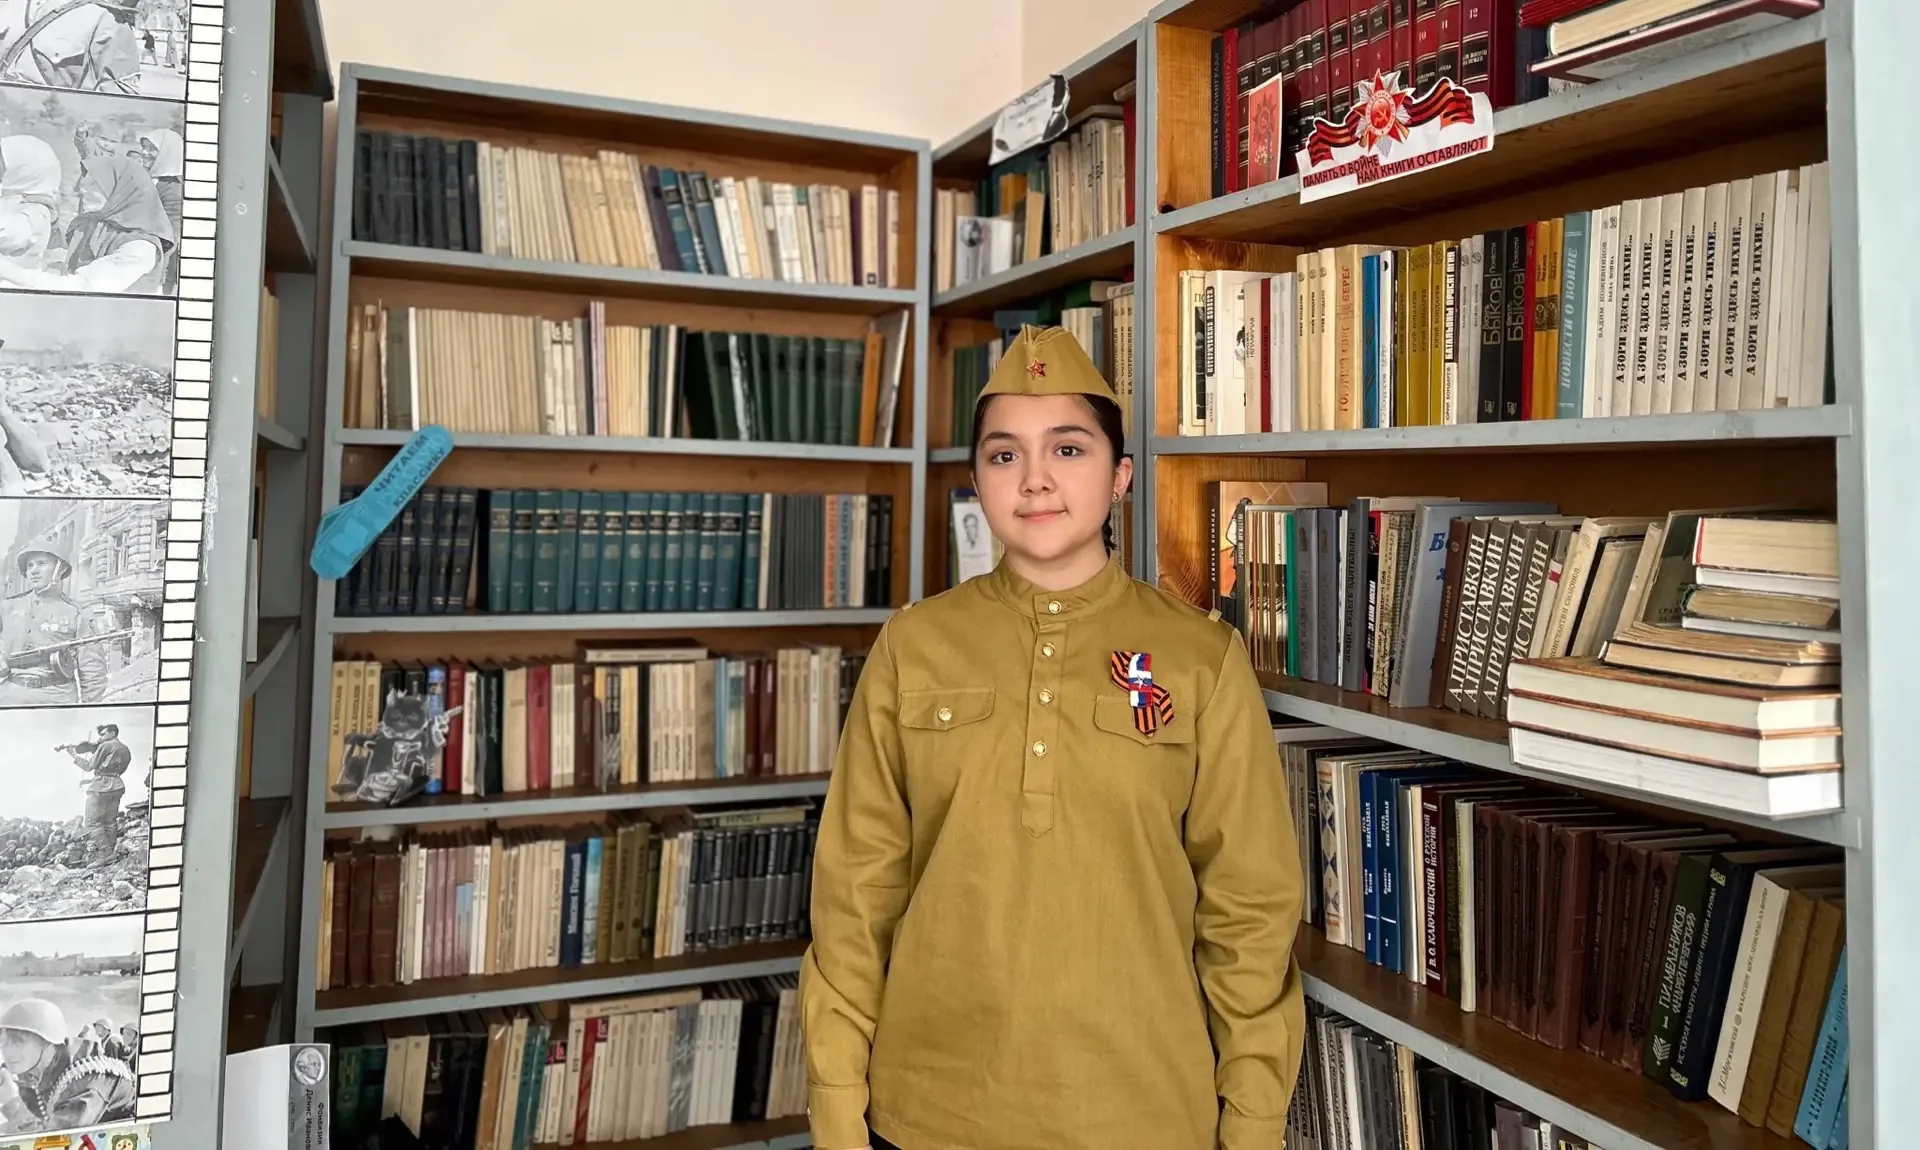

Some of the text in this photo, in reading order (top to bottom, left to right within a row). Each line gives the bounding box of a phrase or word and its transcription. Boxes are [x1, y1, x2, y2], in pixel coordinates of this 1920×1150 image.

[1469, 8, 1478, 18] 12
[1419, 30, 1427, 41] 10
[1335, 68, 1340, 77] 6
[1303, 155, 1379, 186] ПАМЯТЬ О ВОЙНЕ
[1357, 138, 1486, 184] НАМ КНИГИ ОСТАВЛЯЮТ
[1342, 266, 1350, 301] БЕРЕГ
[1599, 242, 1607, 302] КОЖЕВНИКОВ
[1445, 251, 1455, 359] БАТАЛЬОНЫ ПРОСЯТ ОГНЯ
[1561, 247, 1578, 389] ПОВЕСТИ О ВОЙНЕ
[1619, 292, 1630, 333] ЗДЕСЬ
[1639, 292, 1651, 333] ЗДЕСЬ
[1659, 290, 1671, 332] ЗДЕСЬ
[1681, 286, 1692, 329] ЗДЕСЬ
[1702, 284, 1714, 328] ЗДЕСЬ
[1728, 280, 1740, 325] ЗДЕСЬ
[1749, 277, 1762, 322] ЗДЕСЬ
[1616, 337, 1628, 372] ЗОРИ
[1637, 337, 1648, 372] ЗОРИ
[1658, 336, 1668, 371] ЗОРИ
[1678, 333, 1690, 368] ЗОРИ
[1700, 331, 1712, 367] ЗОРИ
[1725, 328, 1737, 364] ЗОРИ
[1746, 327, 1758, 363] ЗОРИ
[1615, 374, 1625, 384] А
[1637, 374, 1646, 384] А
[1656, 373, 1666, 384] А
[1678, 371, 1688, 381] А
[1699, 369, 1709, 380] А
[1724, 367, 1734, 378] А
[1746, 366, 1756, 376] А
[374, 434, 428, 492] ЧИТАЕМ
[393, 447, 446, 507] КЛАССИКУ
[1348, 528, 1356, 589] БДИТЕЛЬНЫ!
[1511, 539, 1549, 659] ИСТАВКИН
[1564, 567, 1580, 606] СИМОНОВ
[1448, 532, 1485, 702] А.ПРИСТАВКИН
[1463, 532, 1505, 703] А.ПРИСТАВКИН
[1483, 532, 1525, 704] А.ПРИСТАВКИН
[1426, 868, 1436, 967] В. О. КЛЮЧЕВСКИЙ
[1676, 1026, 1691, 1064] ИСТОРИЯ
[1685, 985, 1699, 1026] КУЛЬТУРЫ
[1707, 887, 1717, 909] РИМА
[305, 1089, 313, 1116] Денис
